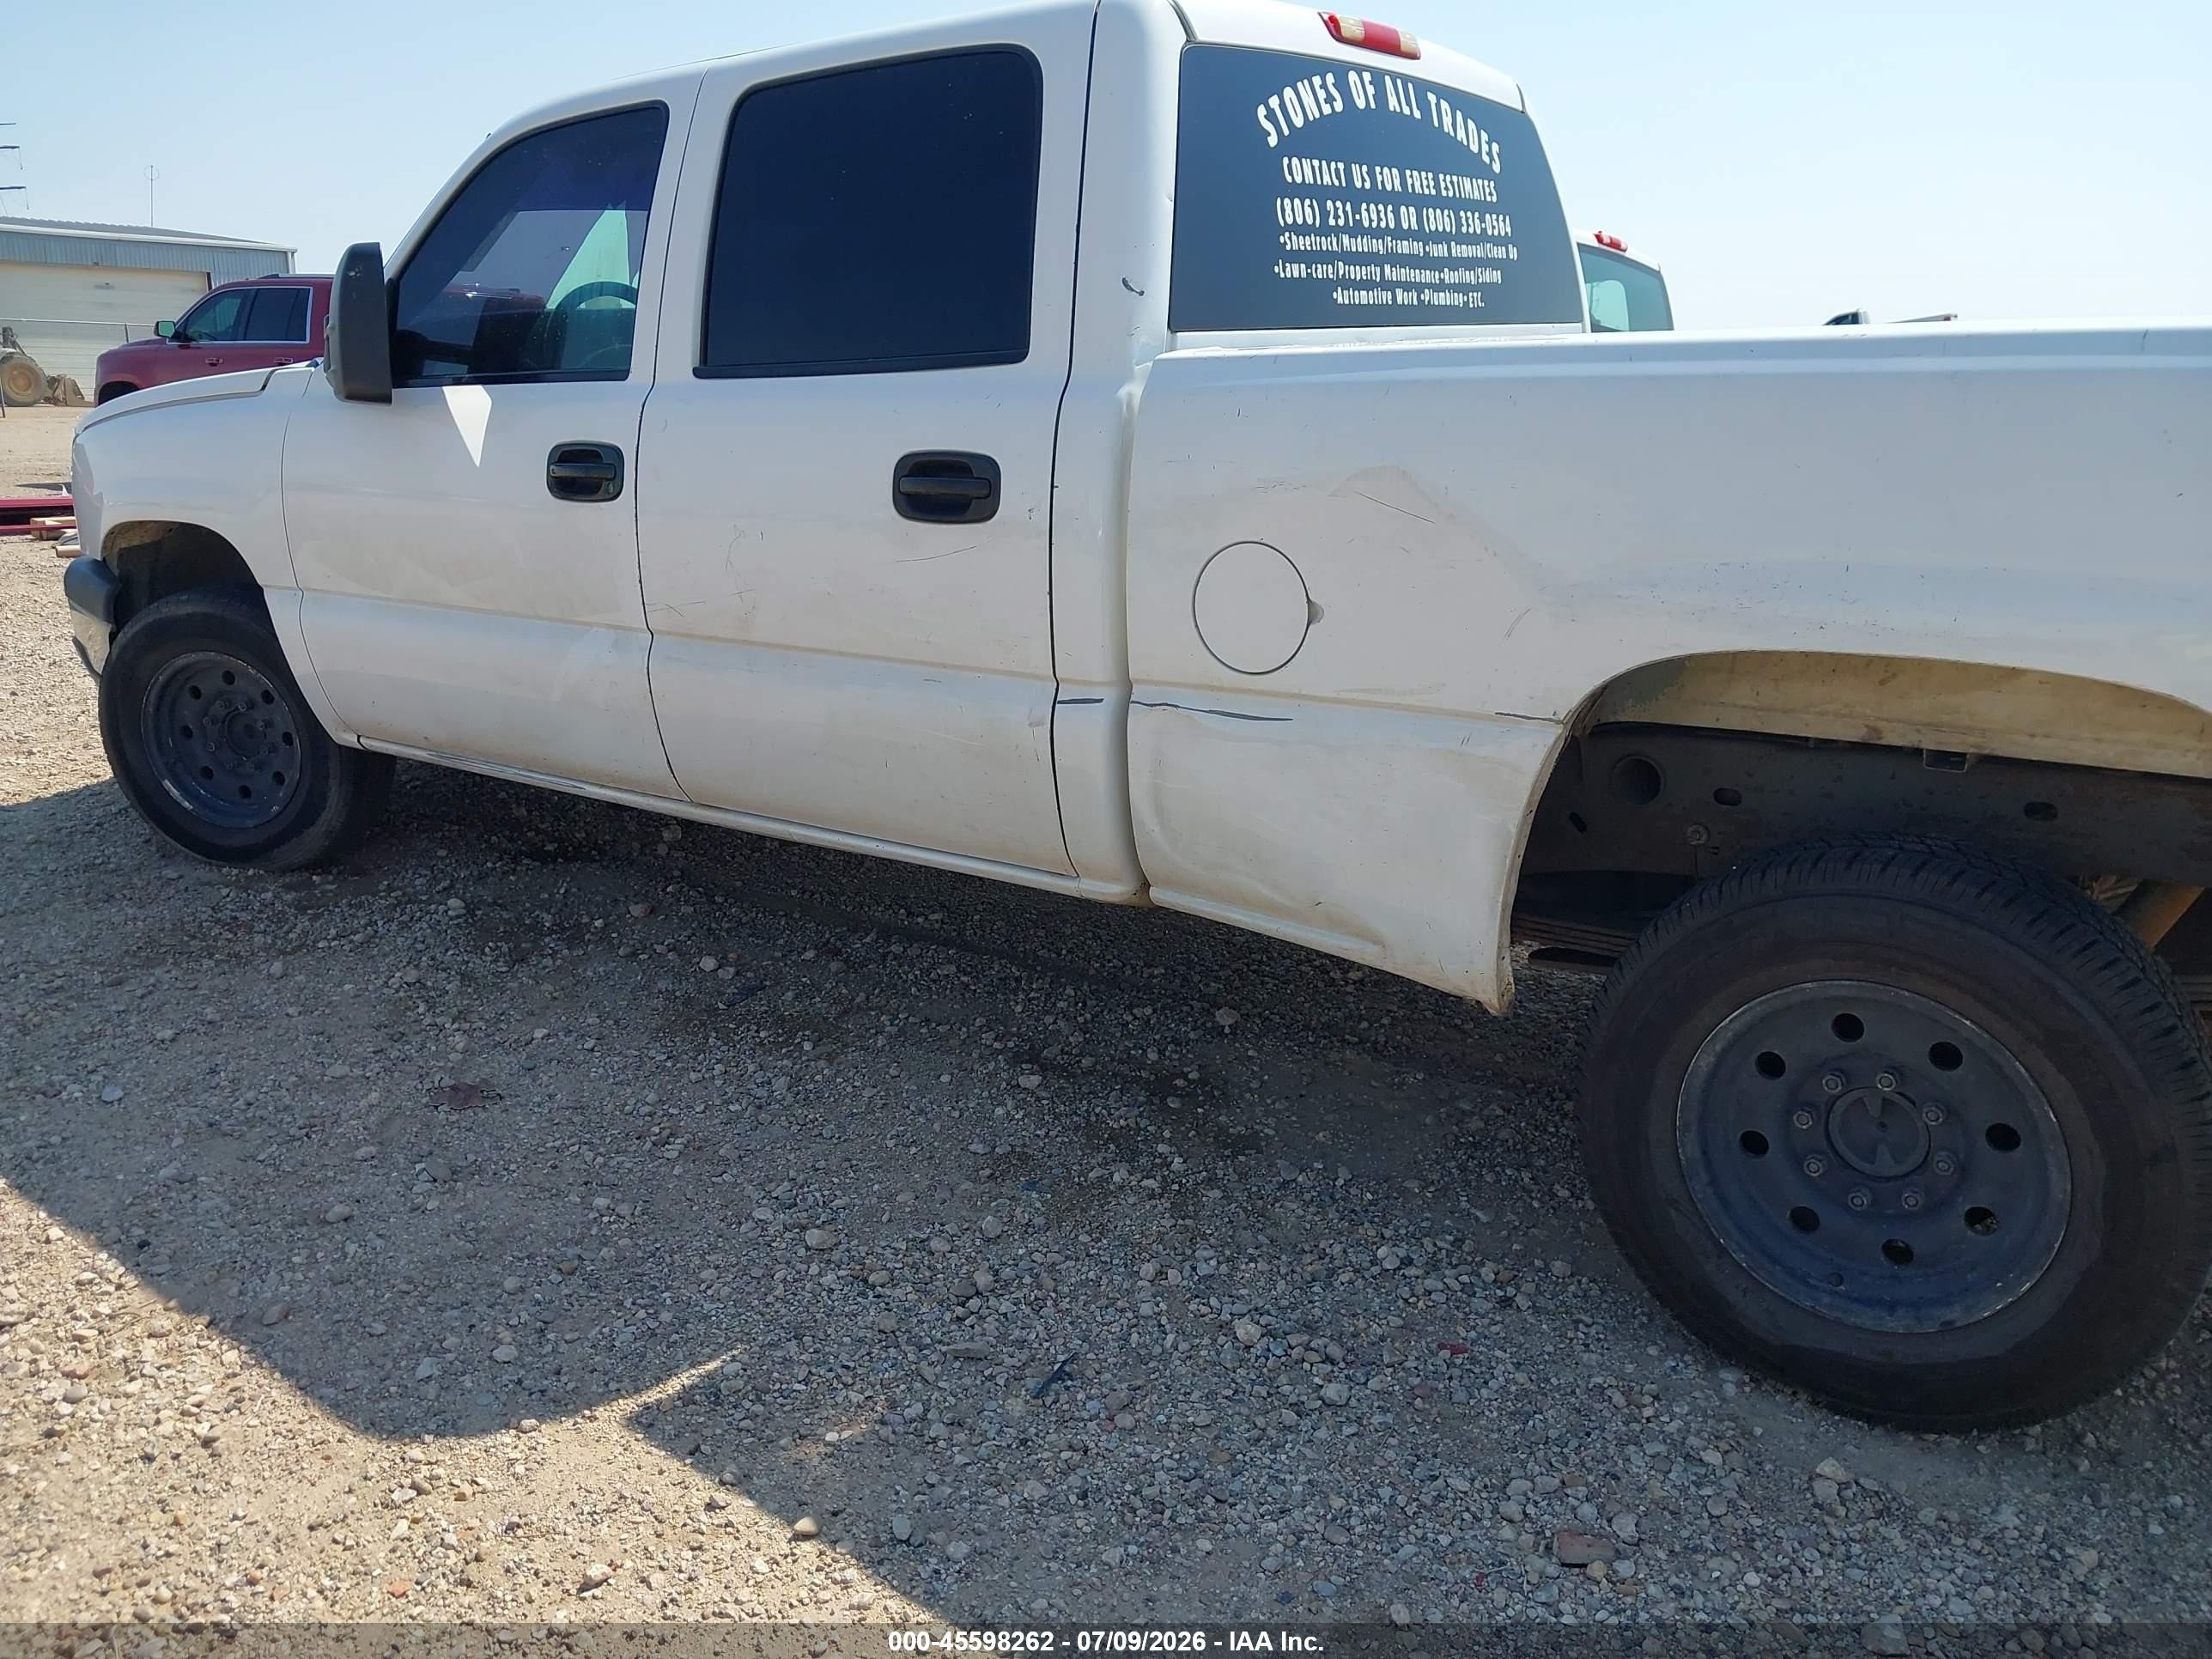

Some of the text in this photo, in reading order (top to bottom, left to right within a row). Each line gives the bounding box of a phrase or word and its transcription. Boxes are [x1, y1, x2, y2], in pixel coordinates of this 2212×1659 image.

[1256, 70, 1501, 174] STONES OF ALL TRADES
[1282, 155, 1498, 204] CONTACT US FOR FREE ESTIMATES
[1276, 197, 1512, 238] (806) 231-6936 OR (806) 336-0564
[1507, 243, 1518, 262] Up
[1395, 288, 1419, 306] Work
